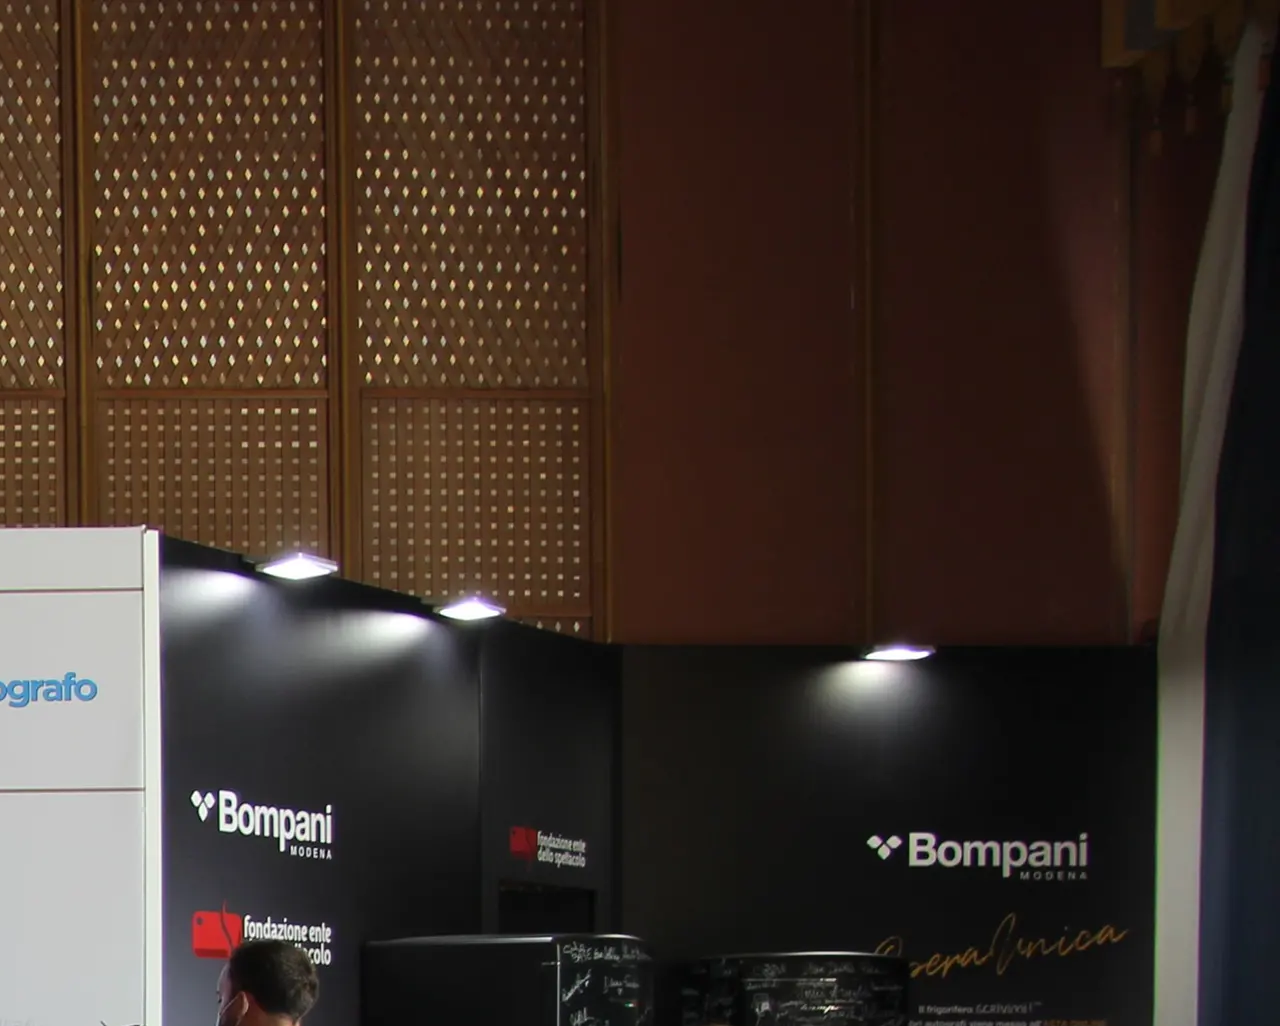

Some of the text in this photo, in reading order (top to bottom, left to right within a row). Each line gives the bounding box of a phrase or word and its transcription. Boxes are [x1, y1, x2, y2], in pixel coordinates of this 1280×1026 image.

[218, 790, 332, 852] Bompani
[537, 831, 573, 851] fondazione
[290, 845, 332, 860] MODENA
[537, 847, 586, 868] dello spettacolo
[908, 832, 1088, 878] Bompani
[1020, 871, 1087, 880] MODENA
[244, 914, 332, 944] fondazione ente
